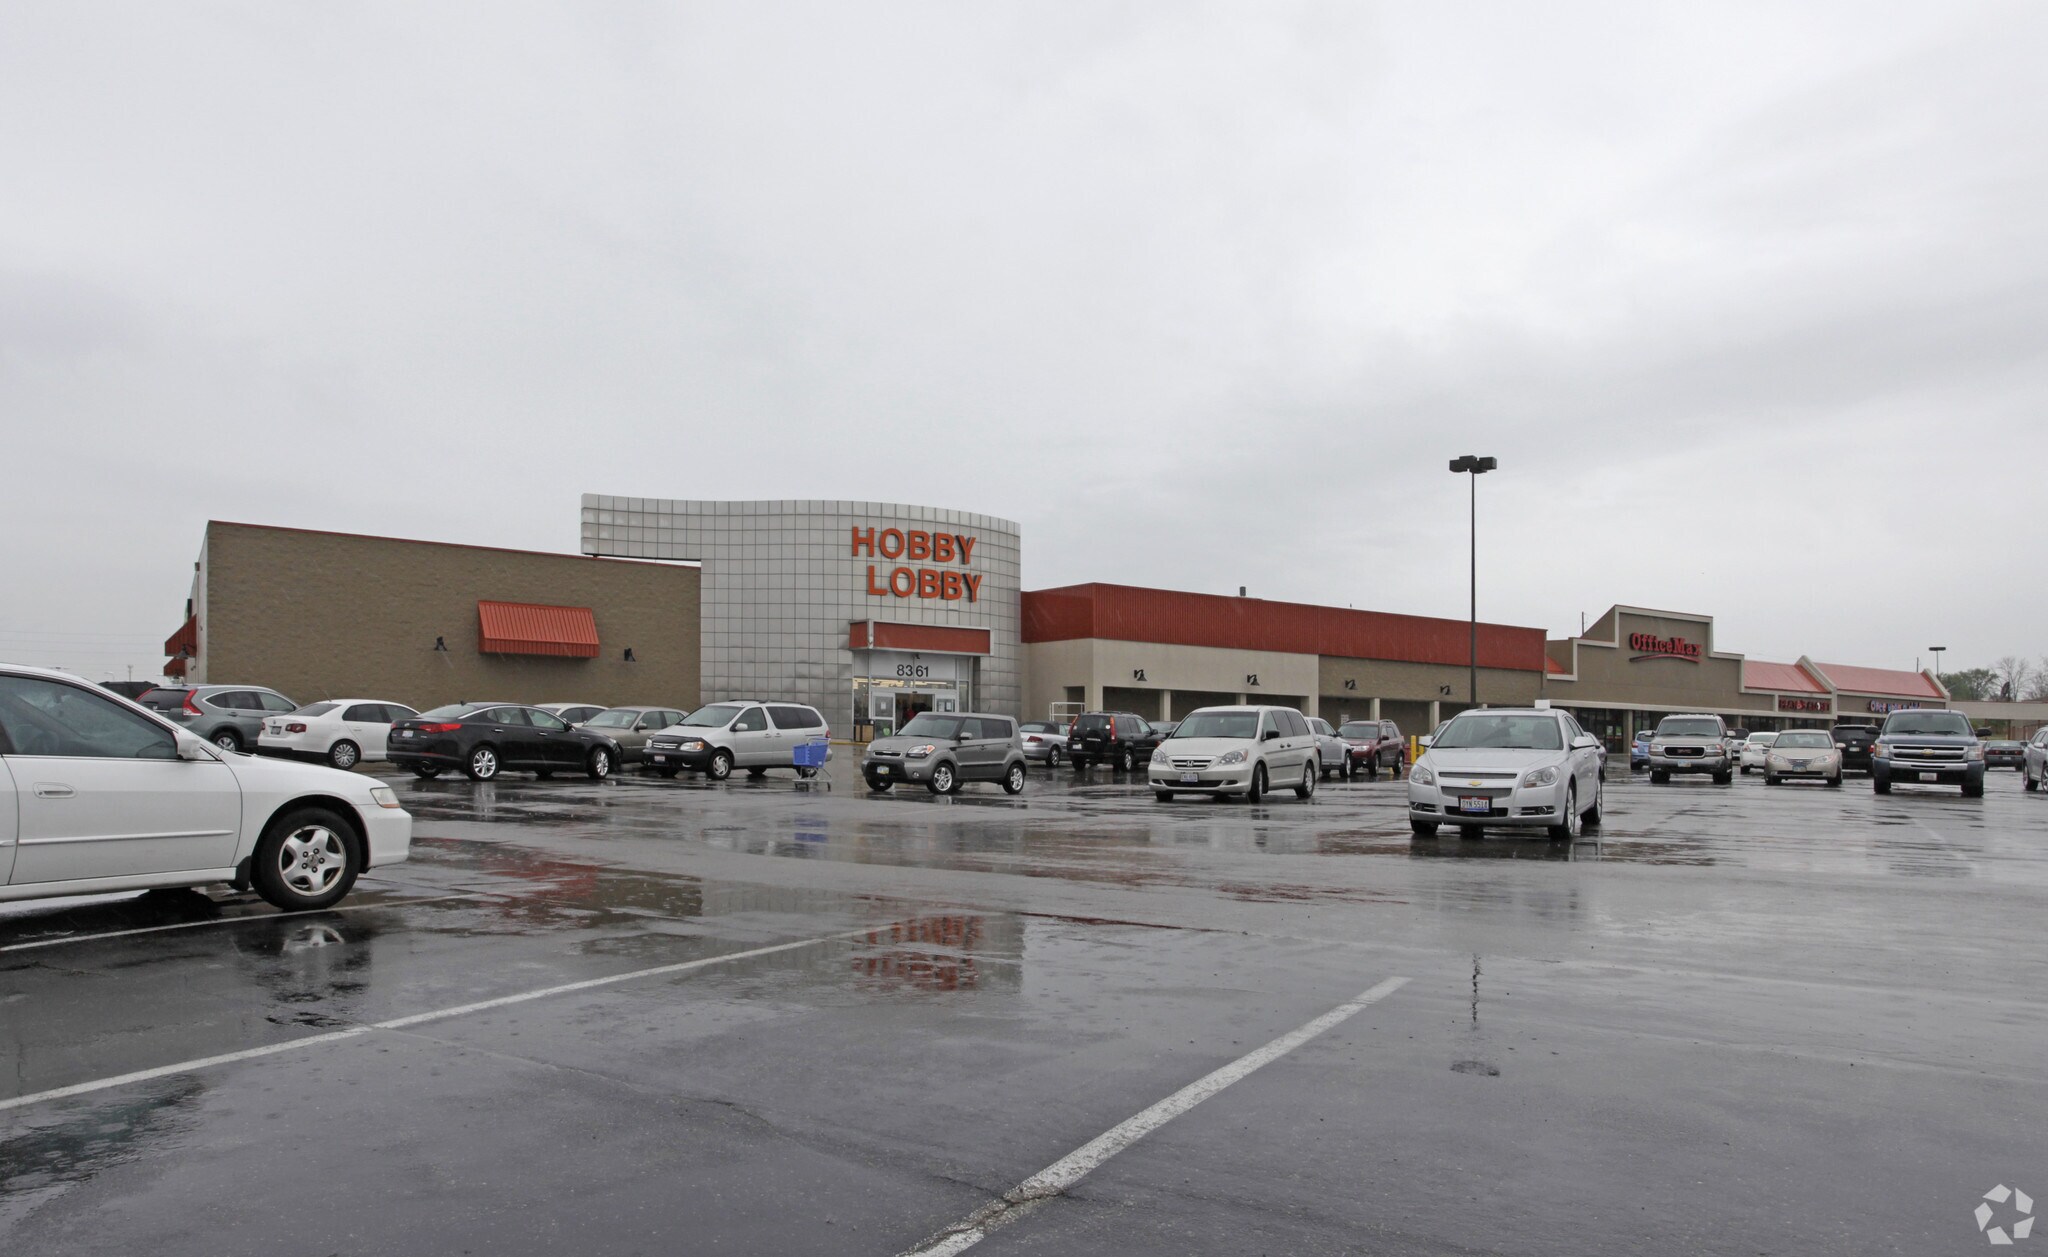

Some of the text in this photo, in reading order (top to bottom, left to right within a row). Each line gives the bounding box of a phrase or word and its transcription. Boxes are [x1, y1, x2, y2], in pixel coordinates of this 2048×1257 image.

[851, 526, 977, 565] HOBBY
[867, 565, 983, 603] LOBBY
[1630, 633, 1702, 656] OfficeMax
[896, 664, 929, 678] 8361
